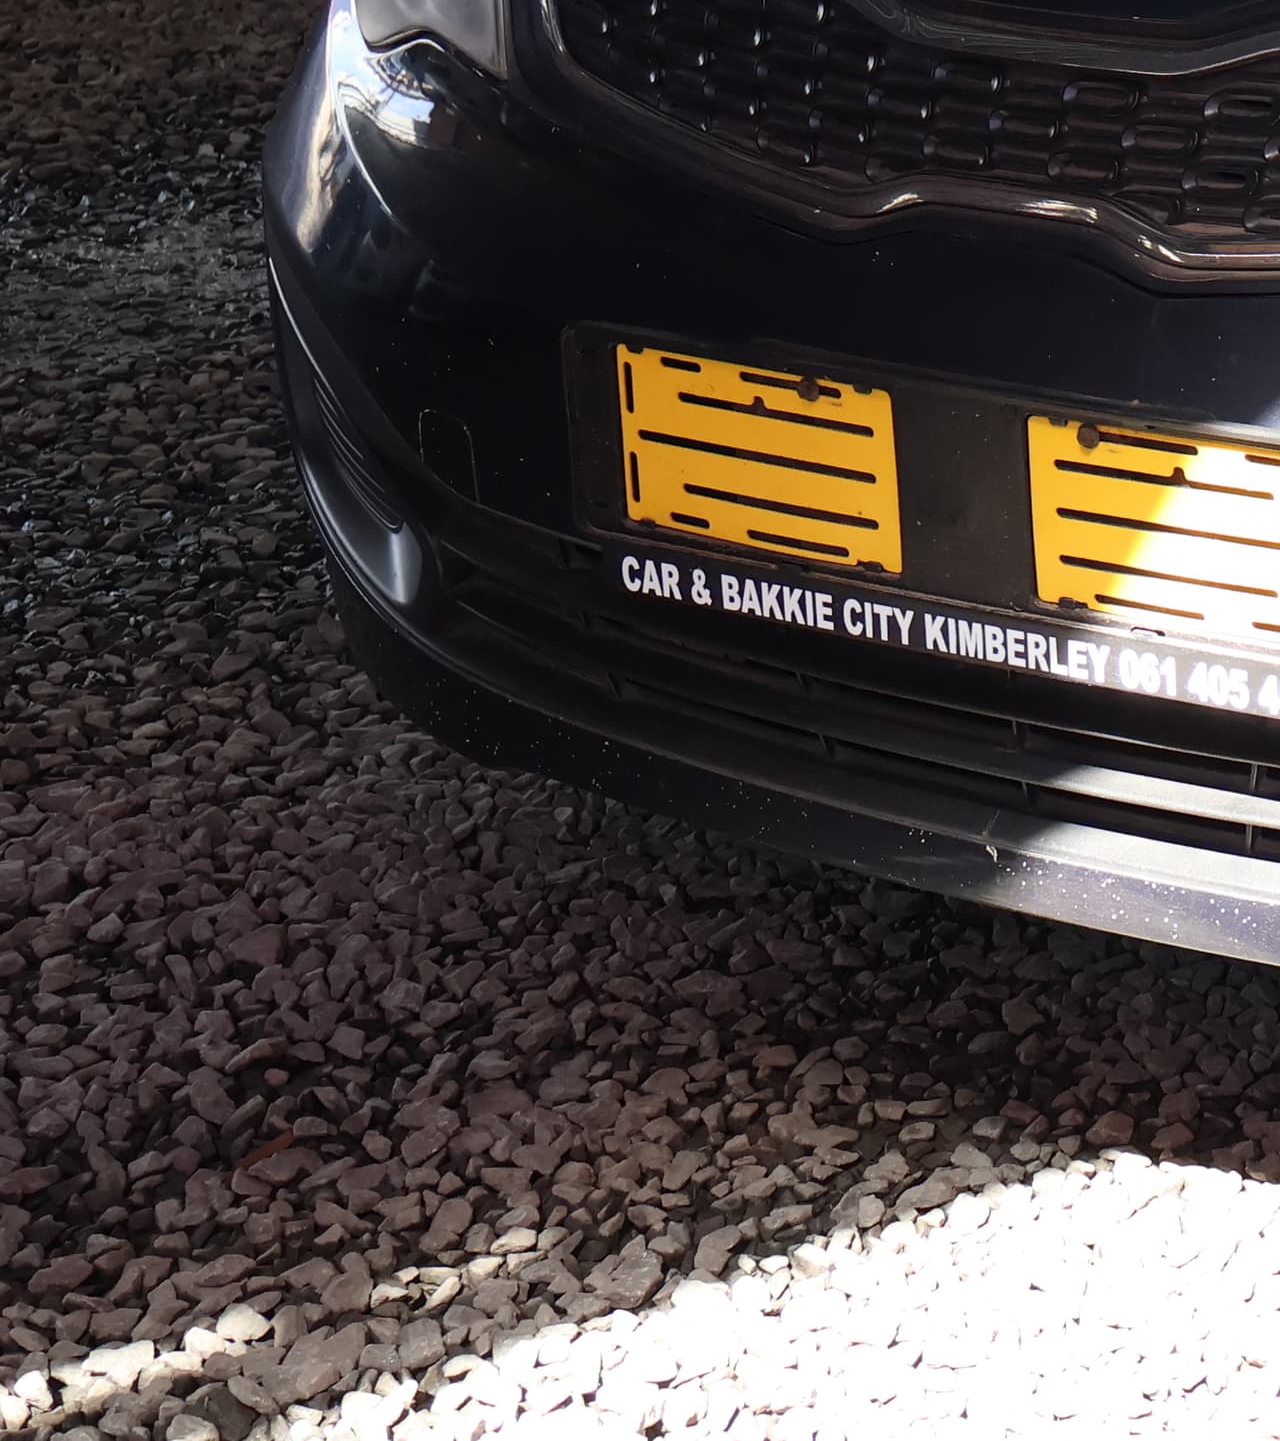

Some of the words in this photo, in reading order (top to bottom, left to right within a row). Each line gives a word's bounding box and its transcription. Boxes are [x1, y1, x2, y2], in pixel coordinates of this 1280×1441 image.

[621, 555, 682, 601] CAR
[690, 568, 712, 607] &
[720, 573, 835, 631] BAKKIE
[843, 598, 914, 646] CITY
[924, 612, 1110, 684] KIMBERLEY
[1118, 648, 1178, 696] 061
[1188, 661, 1250, 711] 405
